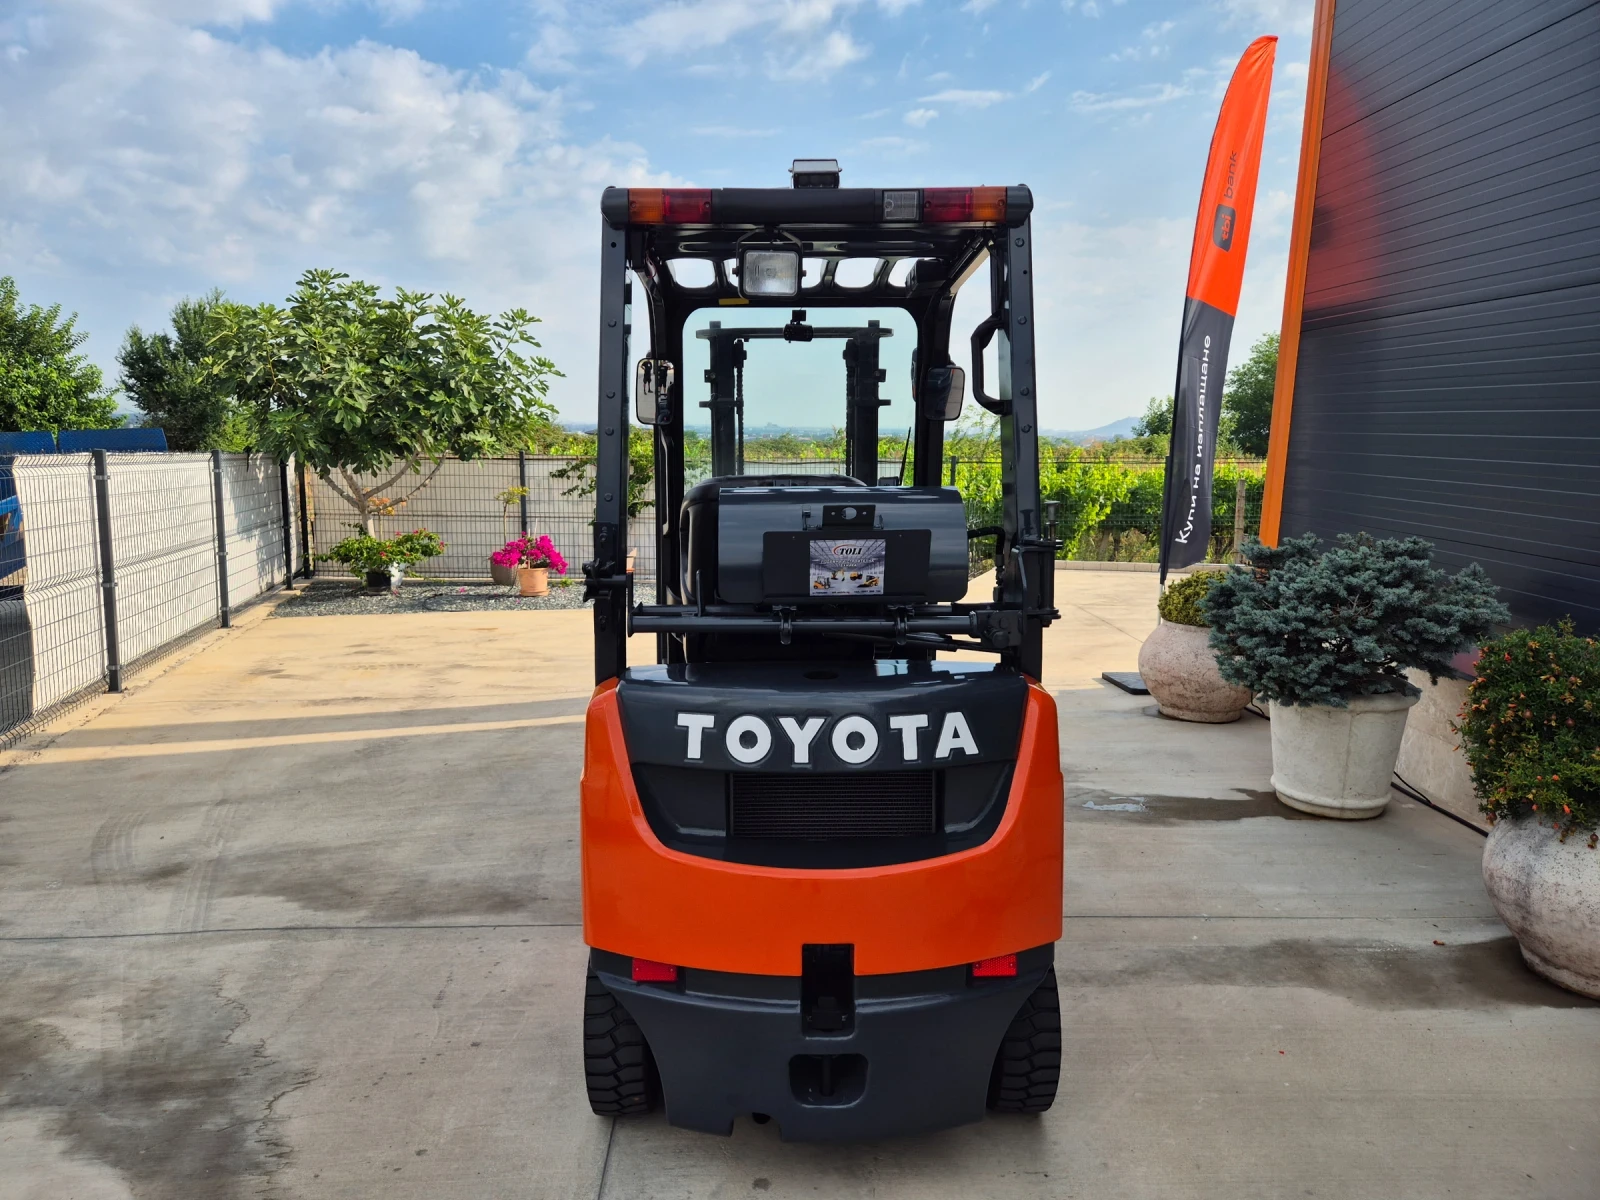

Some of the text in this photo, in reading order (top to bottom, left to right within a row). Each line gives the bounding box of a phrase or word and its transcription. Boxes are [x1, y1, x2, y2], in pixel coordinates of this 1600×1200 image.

[1221, 150, 1237, 241] tbi bank
[1175, 335, 1211, 544] Купи на изплащане
[839, 547, 863, 556] TOLI
[677, 711, 979, 764] TOYOTA
